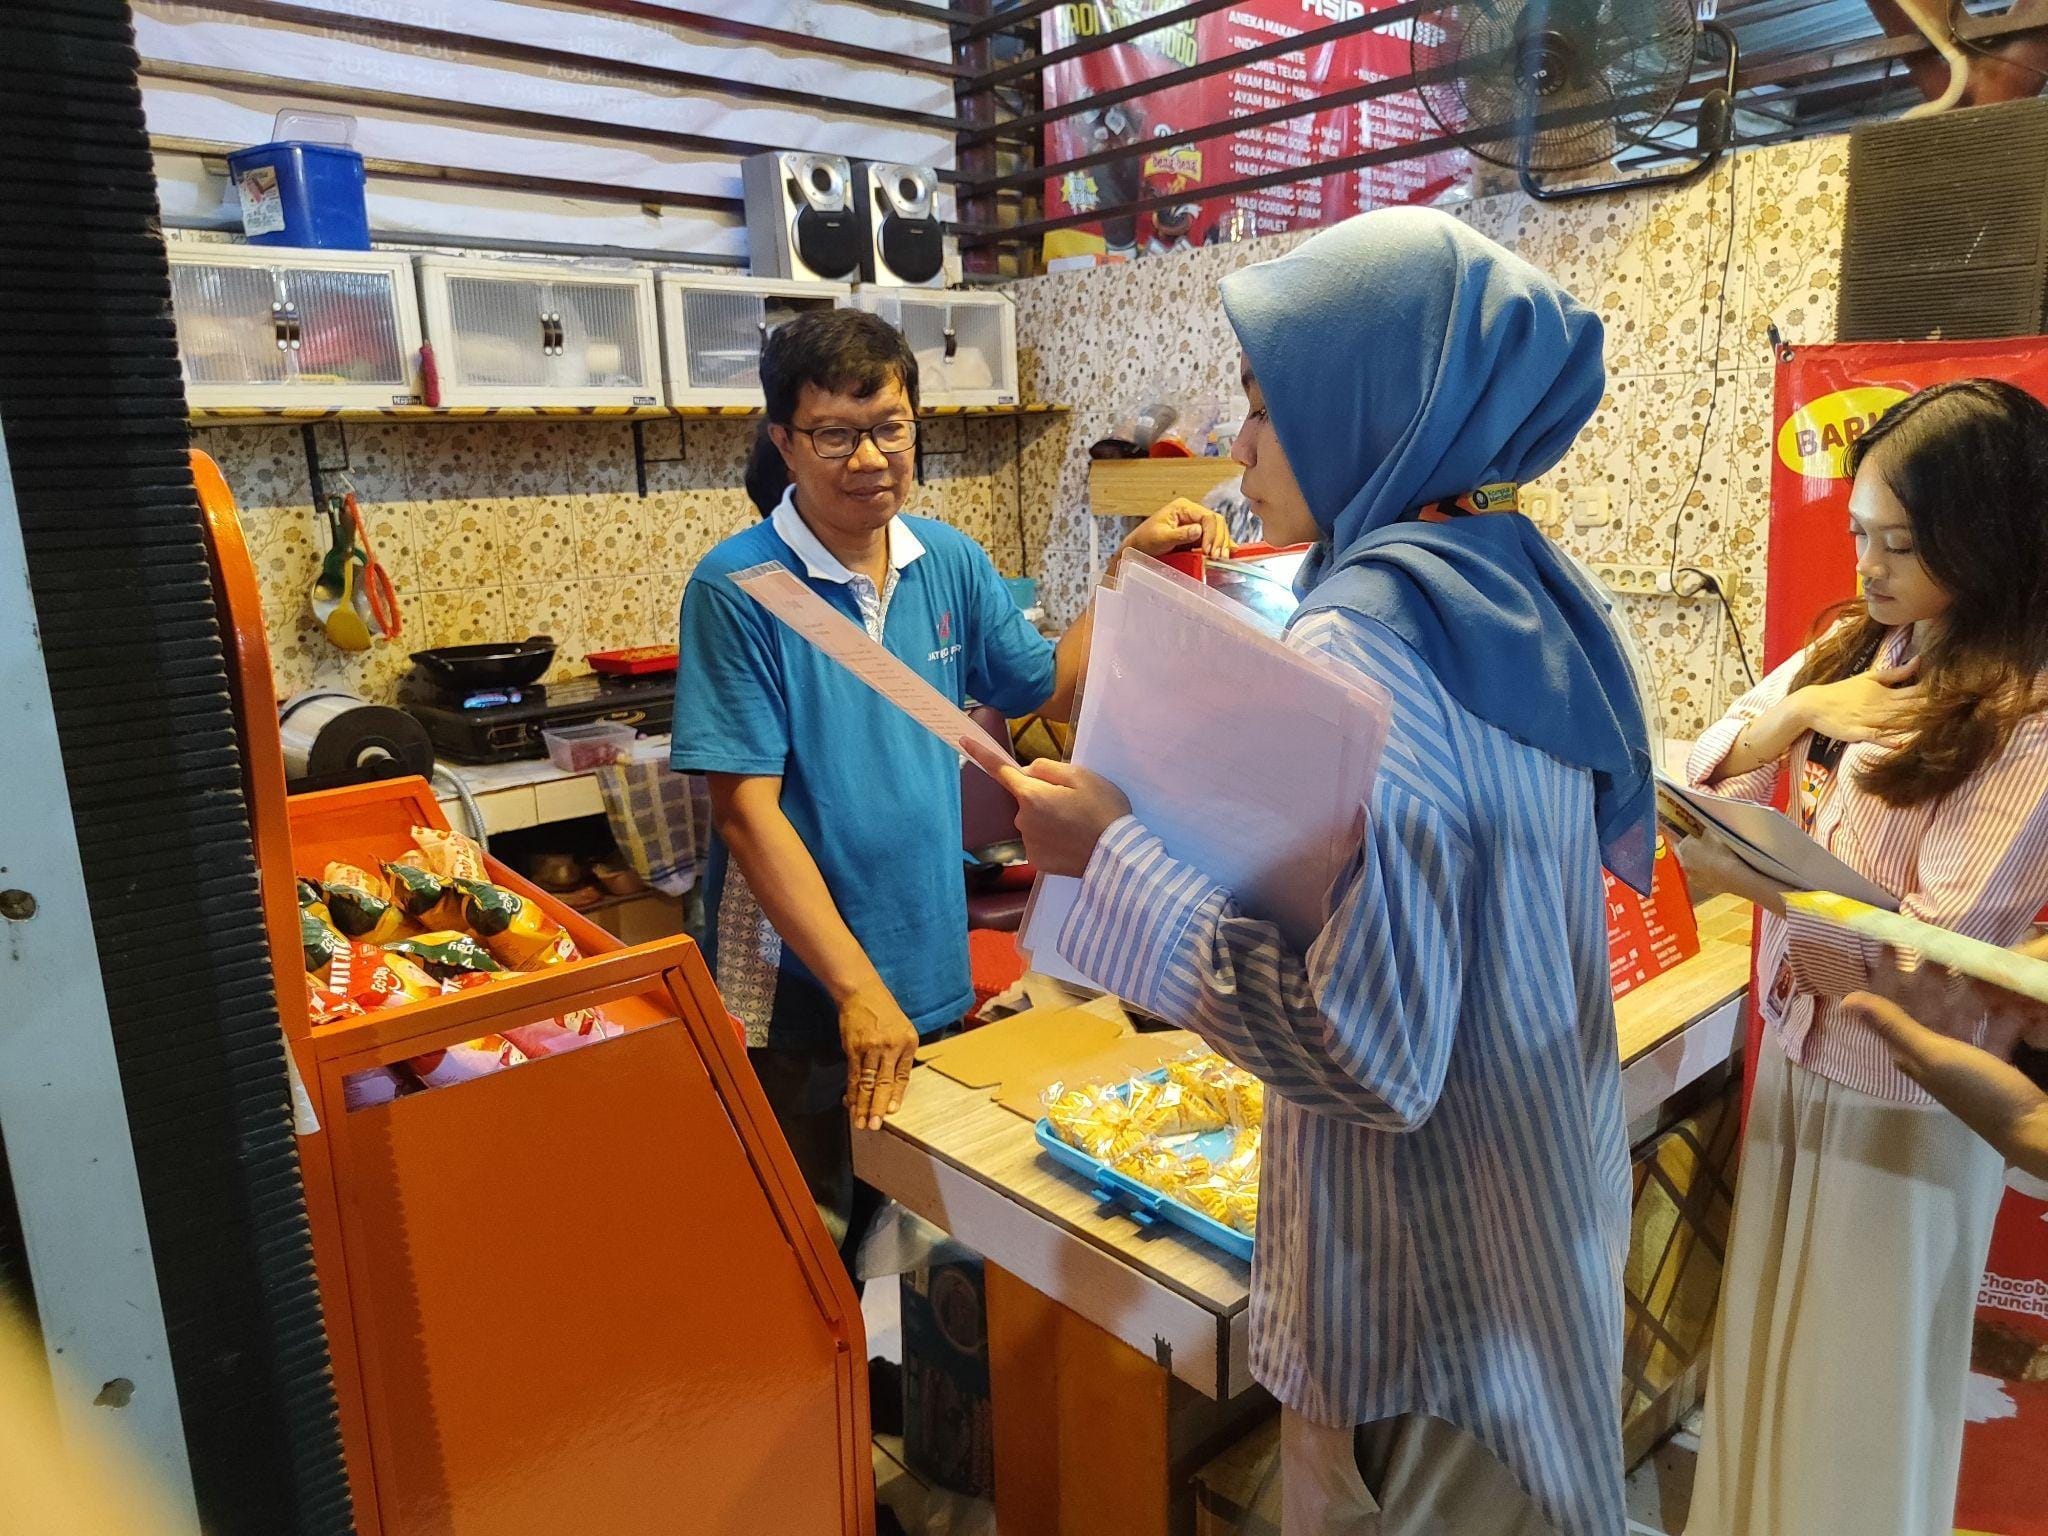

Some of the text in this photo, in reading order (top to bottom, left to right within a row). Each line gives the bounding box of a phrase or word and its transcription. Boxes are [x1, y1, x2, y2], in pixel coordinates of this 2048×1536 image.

[1228, 10, 1265, 32] ANEKA
[1234, 72, 1262, 90] AYAM
[1264, 78, 1286, 94] BALI
[1277, 64, 1307, 80] TELOR
[1234, 90, 1262, 107] AYAM
[1258, 199, 1296, 217] GORENG
[1297, 206, 1321, 220] AYAM
[1796, 409, 1887, 458] BAR
[1981, 1273, 2048, 1298] Chocob
